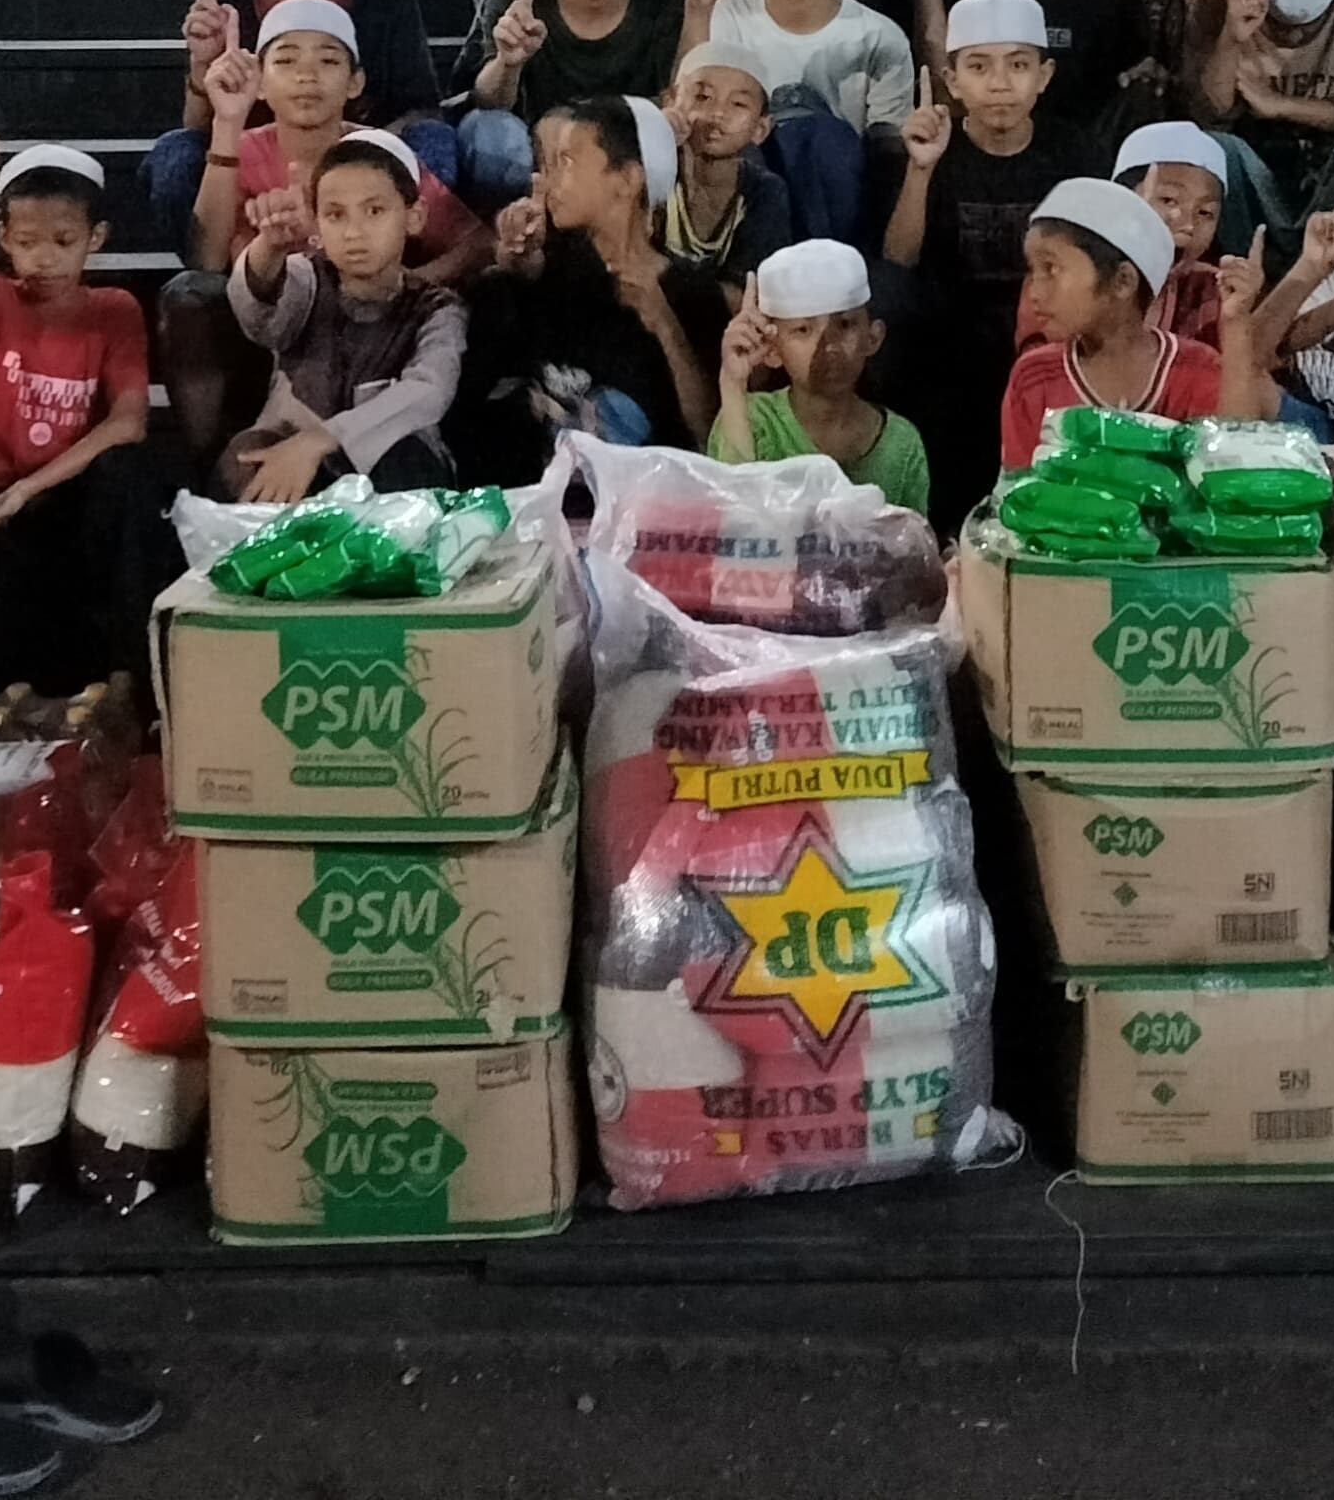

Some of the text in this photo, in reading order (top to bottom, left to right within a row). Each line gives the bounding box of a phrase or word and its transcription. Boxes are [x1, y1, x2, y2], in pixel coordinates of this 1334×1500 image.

[1113, 625, 1230, 670] PSM
[283, 685, 405, 732] PSM
[1262, 721, 1281, 734] 20
[442, 786, 462, 800] 20
[731, 764, 893, 801] DUA PUTRI
[1094, 822, 1154, 850] PSM
[1244, 872, 1275, 893] SNI
[318, 890, 440, 938] PSM
[764, 906, 874, 979] DP
[1131, 1021, 1191, 1046] PSM
[1279, 1069, 1310, 1091] SNI
[325, 1132, 444, 1176] PSM
